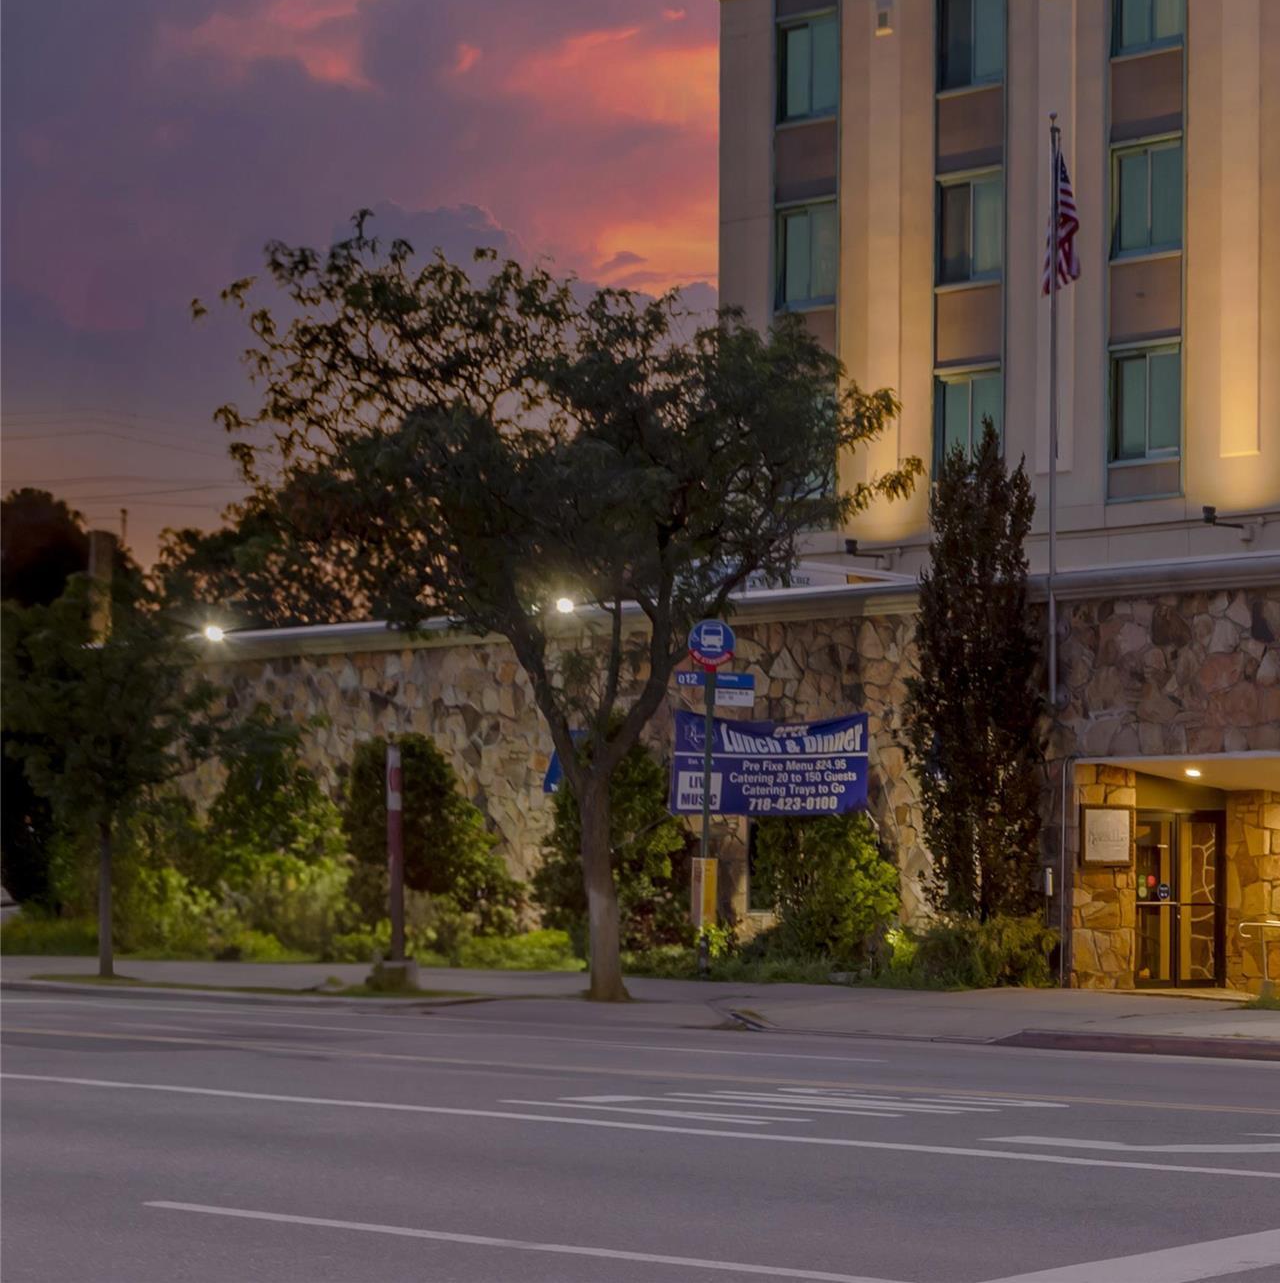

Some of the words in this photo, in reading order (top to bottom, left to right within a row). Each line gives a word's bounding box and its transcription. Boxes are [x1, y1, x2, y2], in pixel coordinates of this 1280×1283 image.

[720, 722, 782, 753] Lunch
[785, 739, 801, 753] &
[803, 723, 863, 753] Dinner
[742, 760, 760, 771] Pre
[762, 760, 783, 771] Fixe
[785, 760, 814, 771] Menu
[689, 775, 709, 789] LIV
[729, 772, 774, 785] Catering
[776, 772, 789, 783] 20
[791, 773, 802, 783] to
[805, 771, 822, 782] 150
[823, 771, 857, 782] Guests
[742, 784, 786, 796] Catering
[789, 783, 816, 796] Trays
[818, 784, 829, 793] to
[830, 782, 846, 794] Go
[681, 793, 717, 806] MUSC
[748, 796, 838, 811] 718-423-0100
